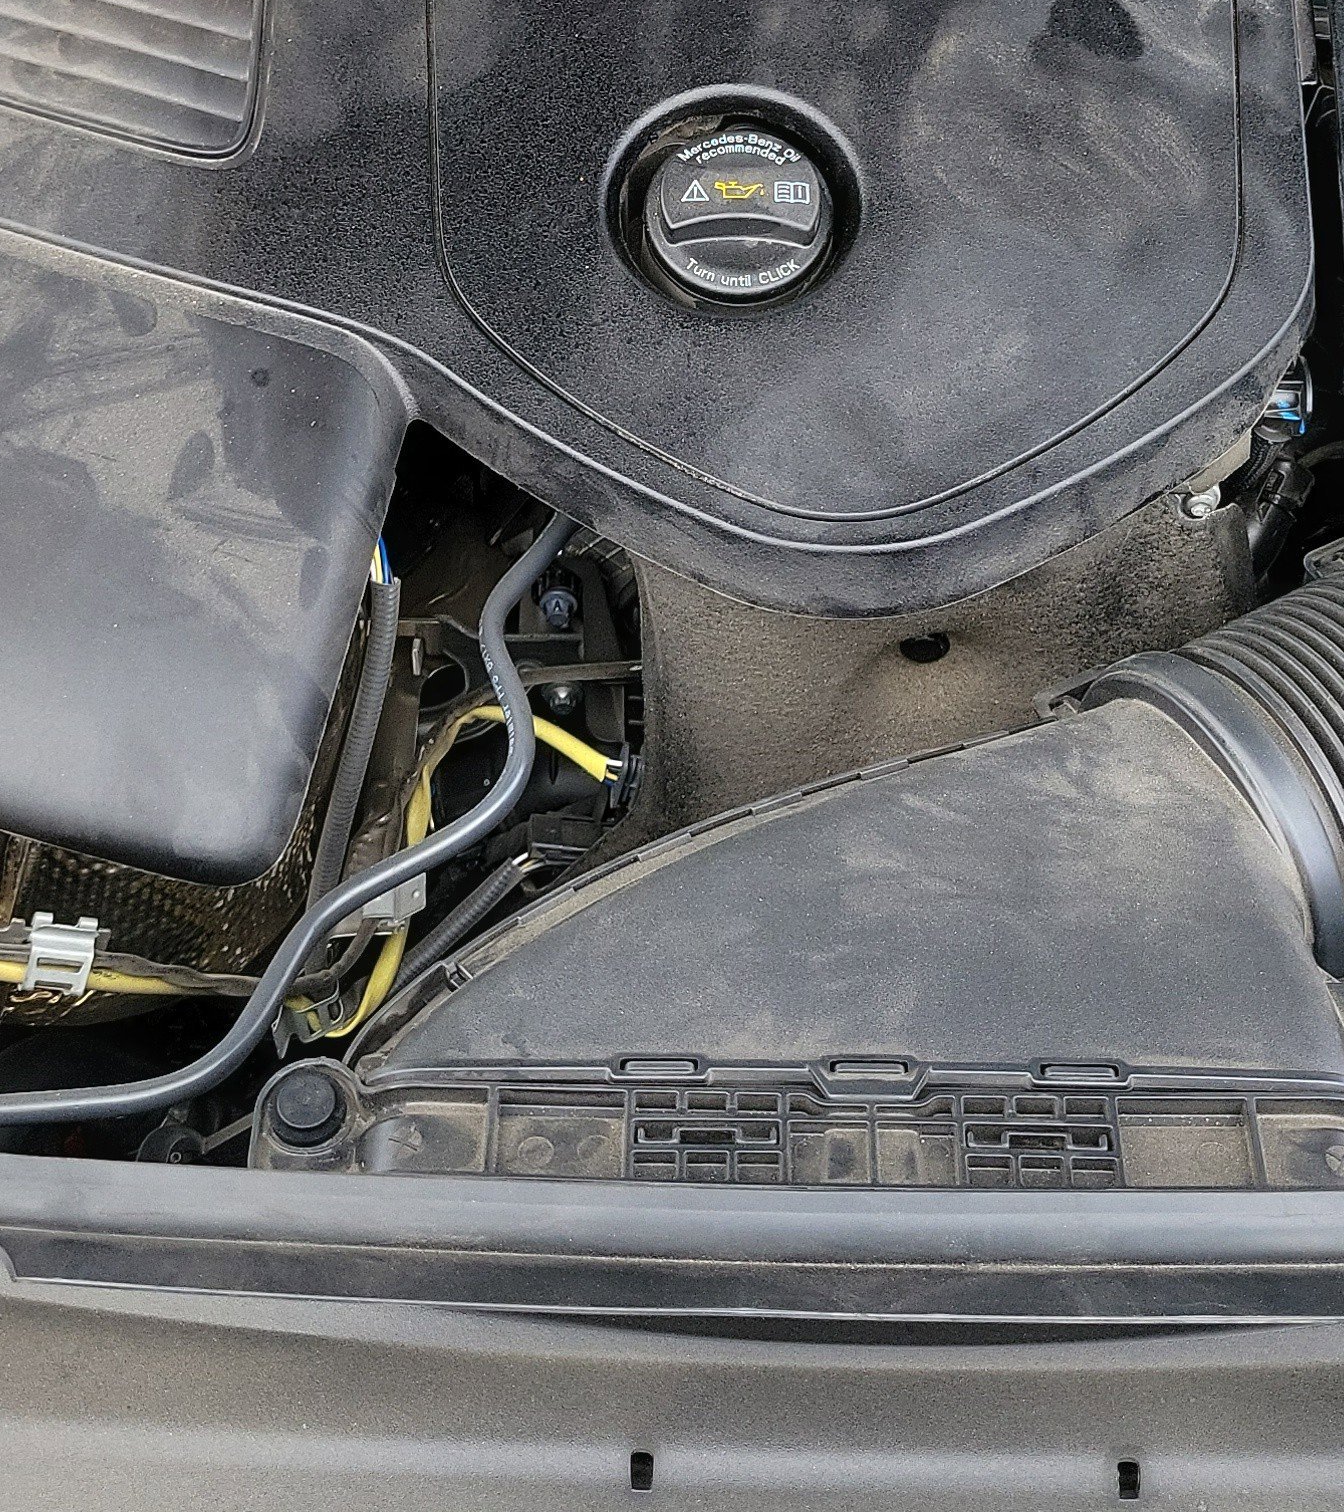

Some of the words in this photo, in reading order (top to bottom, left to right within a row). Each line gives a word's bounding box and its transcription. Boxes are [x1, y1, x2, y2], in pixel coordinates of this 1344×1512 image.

[677, 133, 782, 163] Mercedes-Benz
[782, 148, 802, 164] Oil
[694, 143, 788, 166] recommended
[685, 257, 716, 283] Turn
[720, 273, 753, 287] until
[757, 258, 802, 286] CLICK
